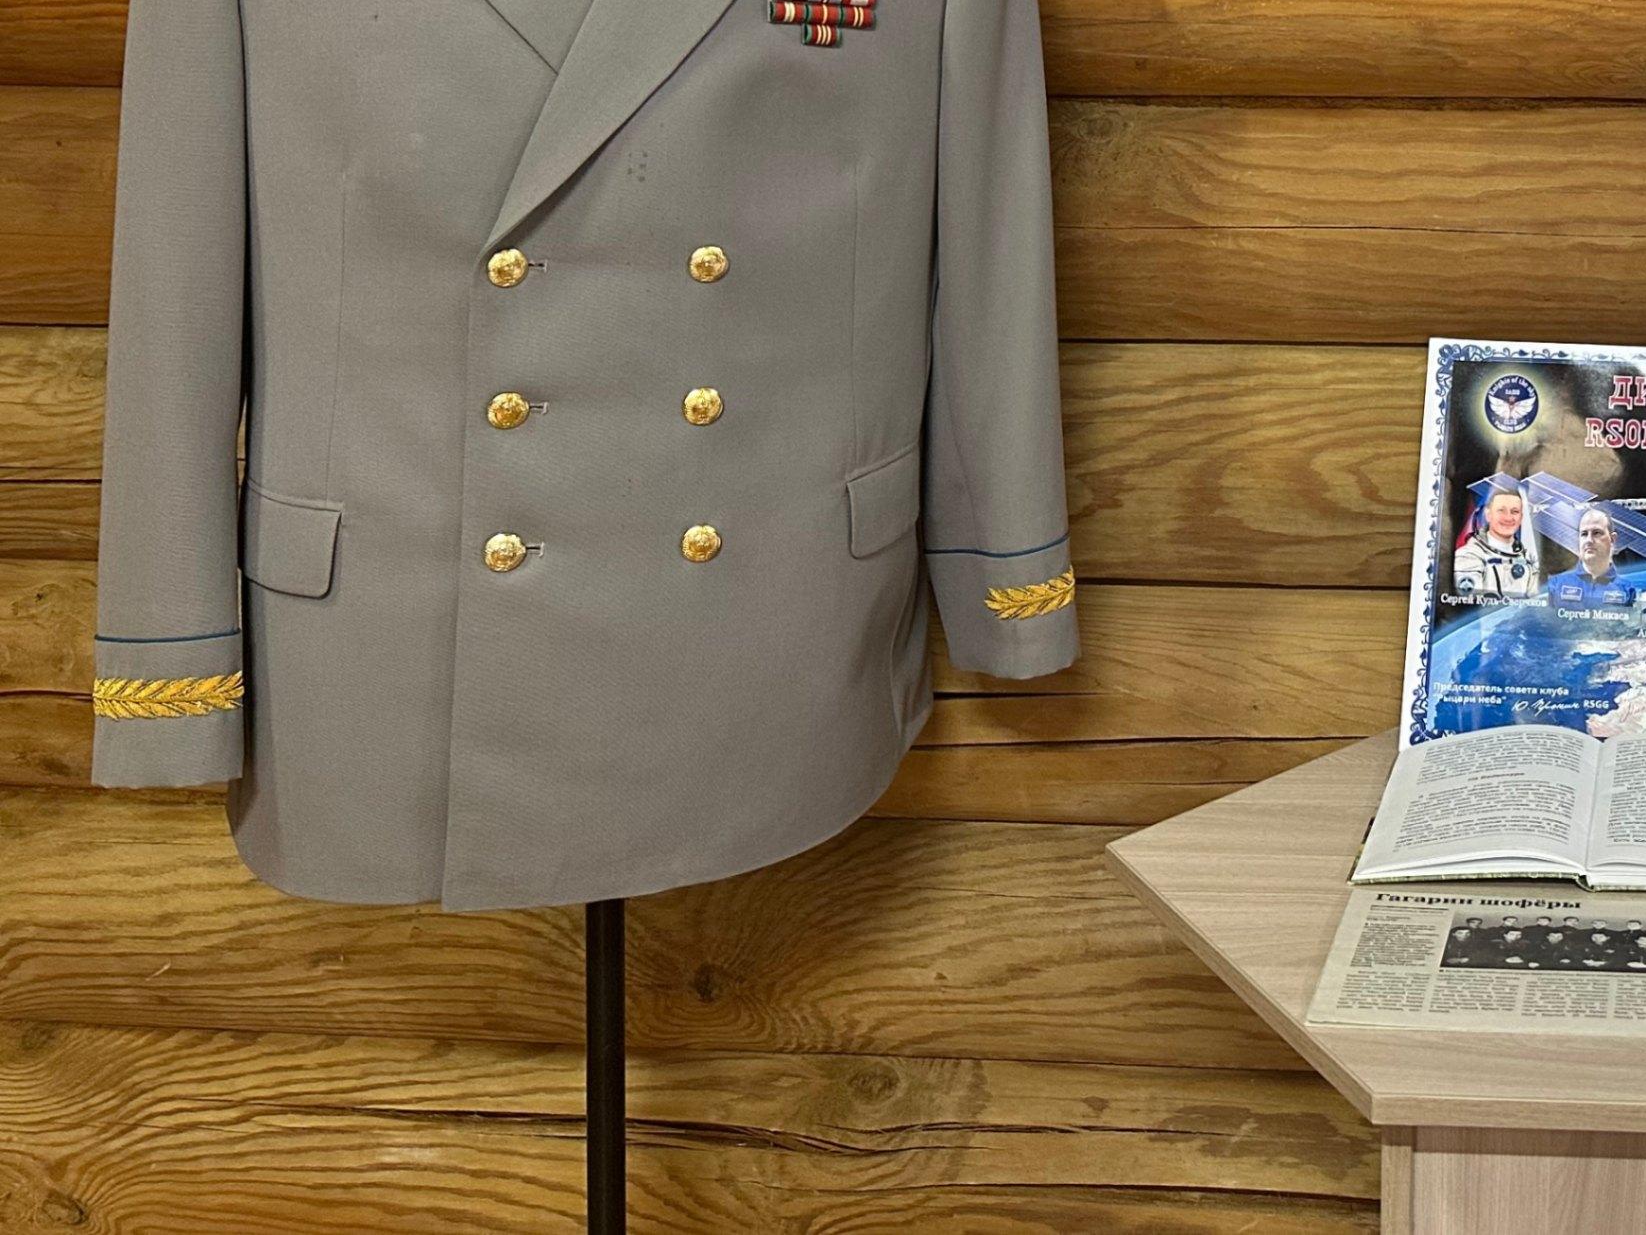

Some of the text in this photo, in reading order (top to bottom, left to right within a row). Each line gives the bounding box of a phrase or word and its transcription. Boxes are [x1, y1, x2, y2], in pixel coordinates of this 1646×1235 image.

[1440, 593, 1474, 606] Сергей
[1557, 607, 1591, 620] Сергей
[1433, 682, 1570, 697] Председатель совета клуба
[1479, 695, 1507, 705] неба"
[1376, 893, 1583, 910] Гагарин шофёры
